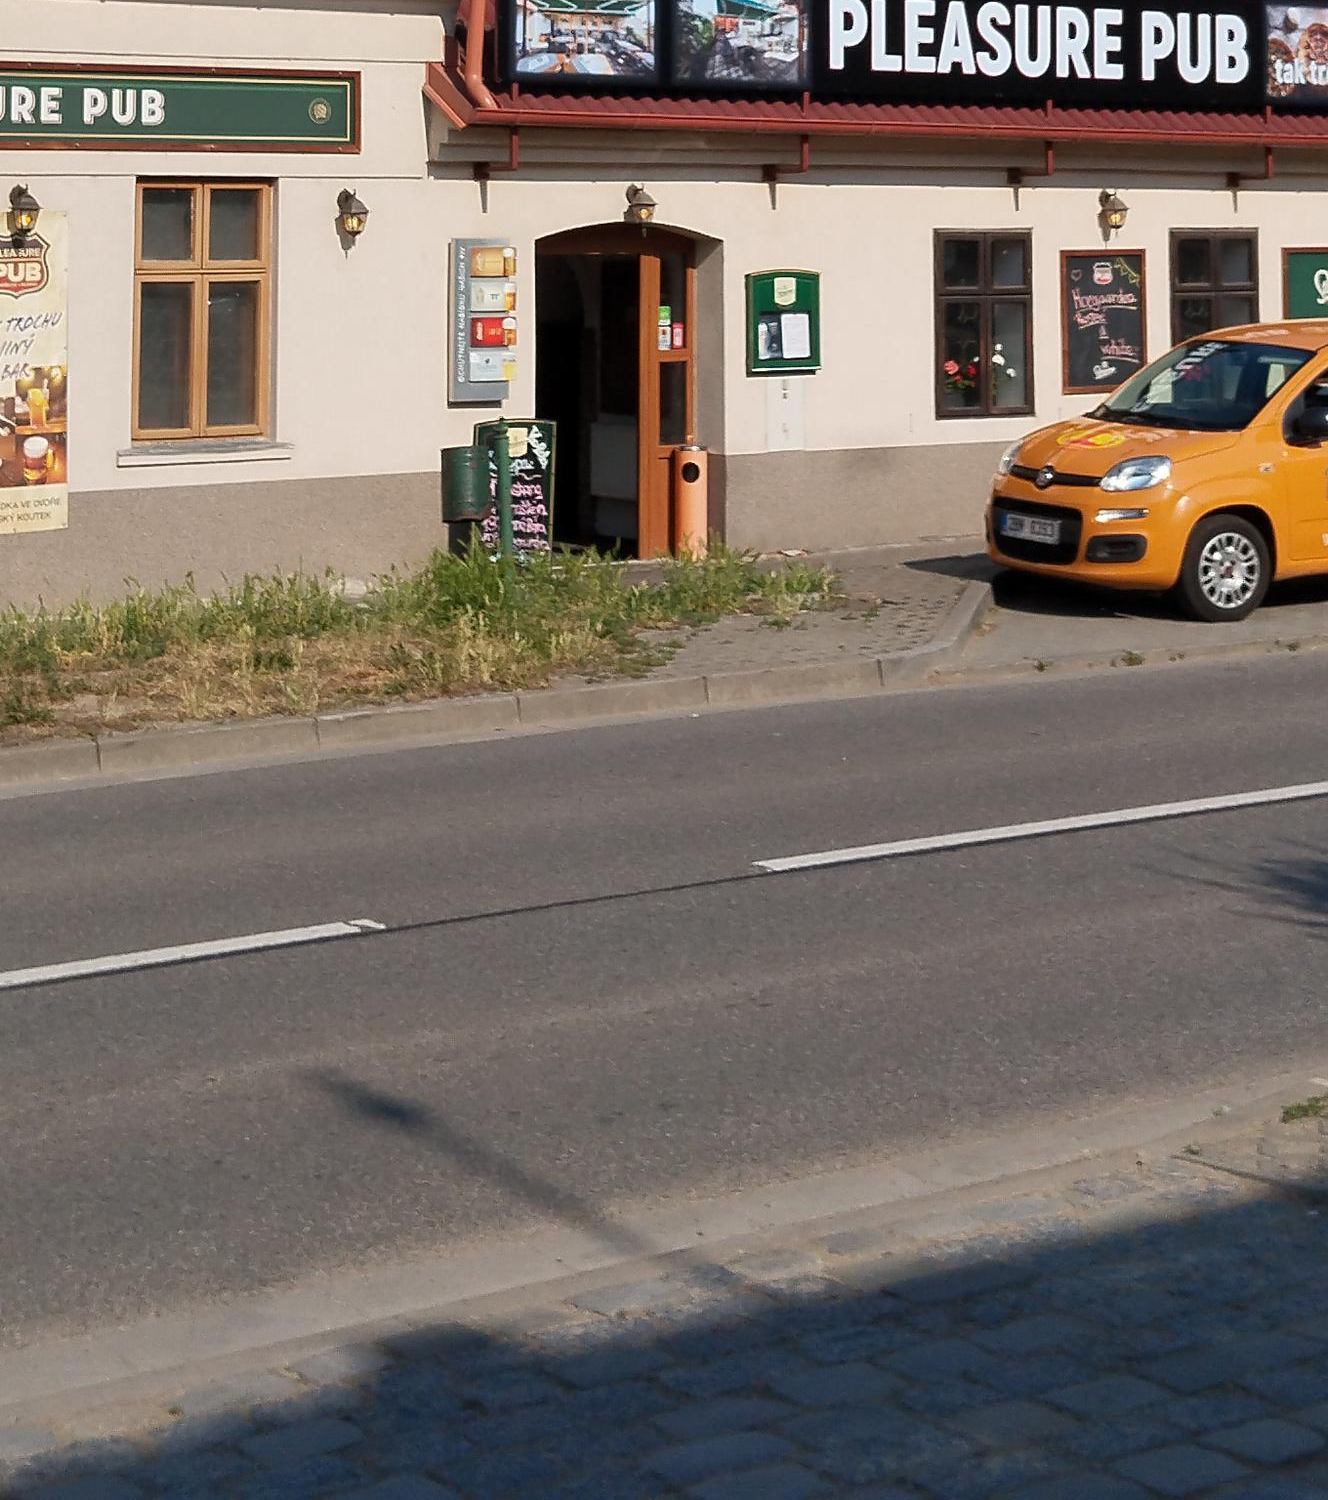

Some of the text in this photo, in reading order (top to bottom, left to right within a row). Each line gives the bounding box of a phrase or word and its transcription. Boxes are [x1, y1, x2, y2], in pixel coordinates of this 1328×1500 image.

[1141, 10, 1250, 85] PUB
[1274, 58, 1306, 85] tak
[83, 87, 166, 126] PUB
[6, 312, 62, 332] TROCHU
[1, 362, 30, 381] BAR
